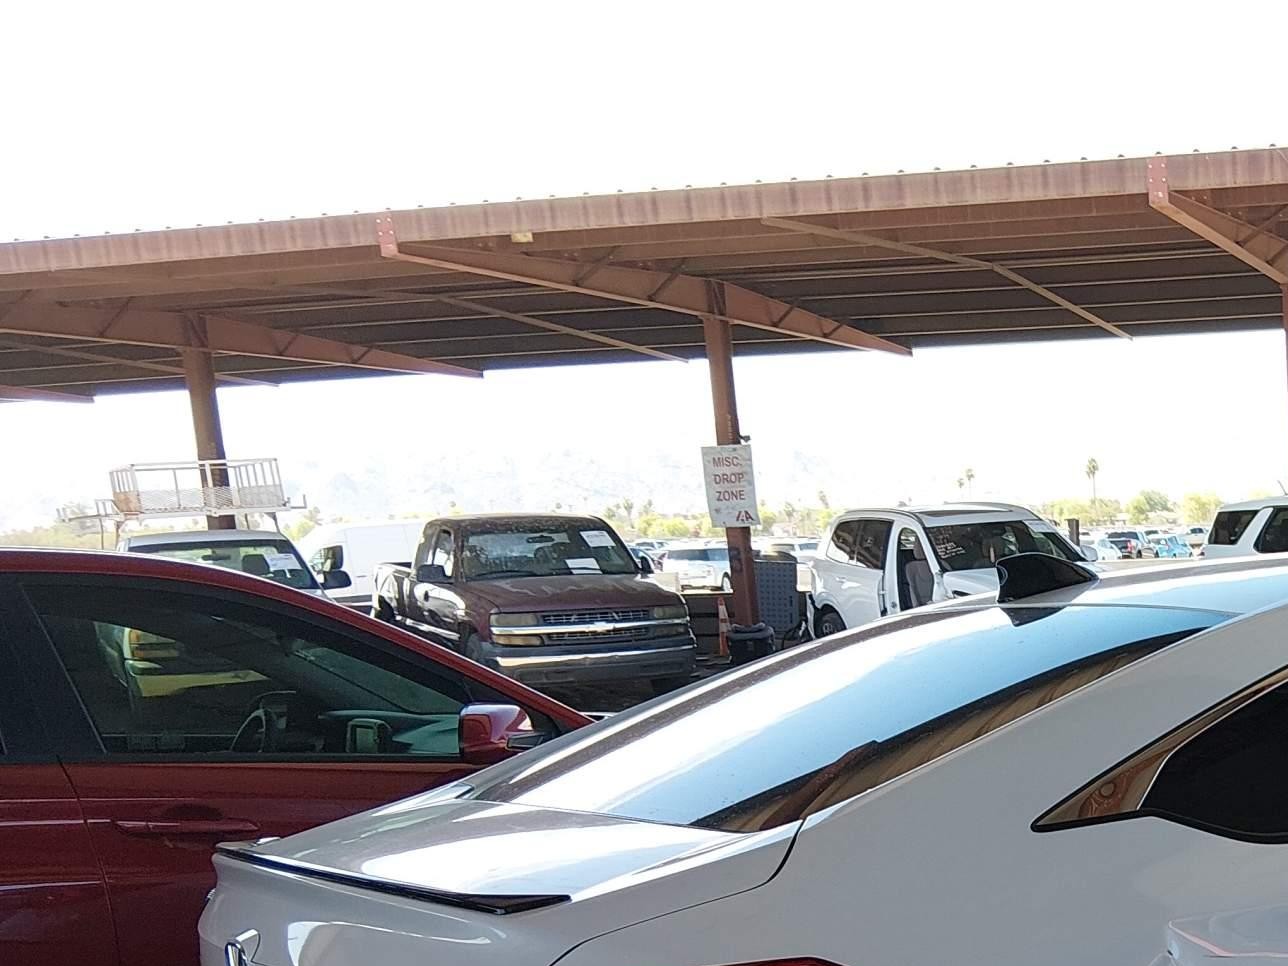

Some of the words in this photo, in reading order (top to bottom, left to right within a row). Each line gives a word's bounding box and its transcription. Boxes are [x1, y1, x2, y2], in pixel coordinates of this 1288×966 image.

[712, 456, 742, 468] MISC.
[713, 473, 744, 485] DROP
[716, 490, 745, 501] ZONE
